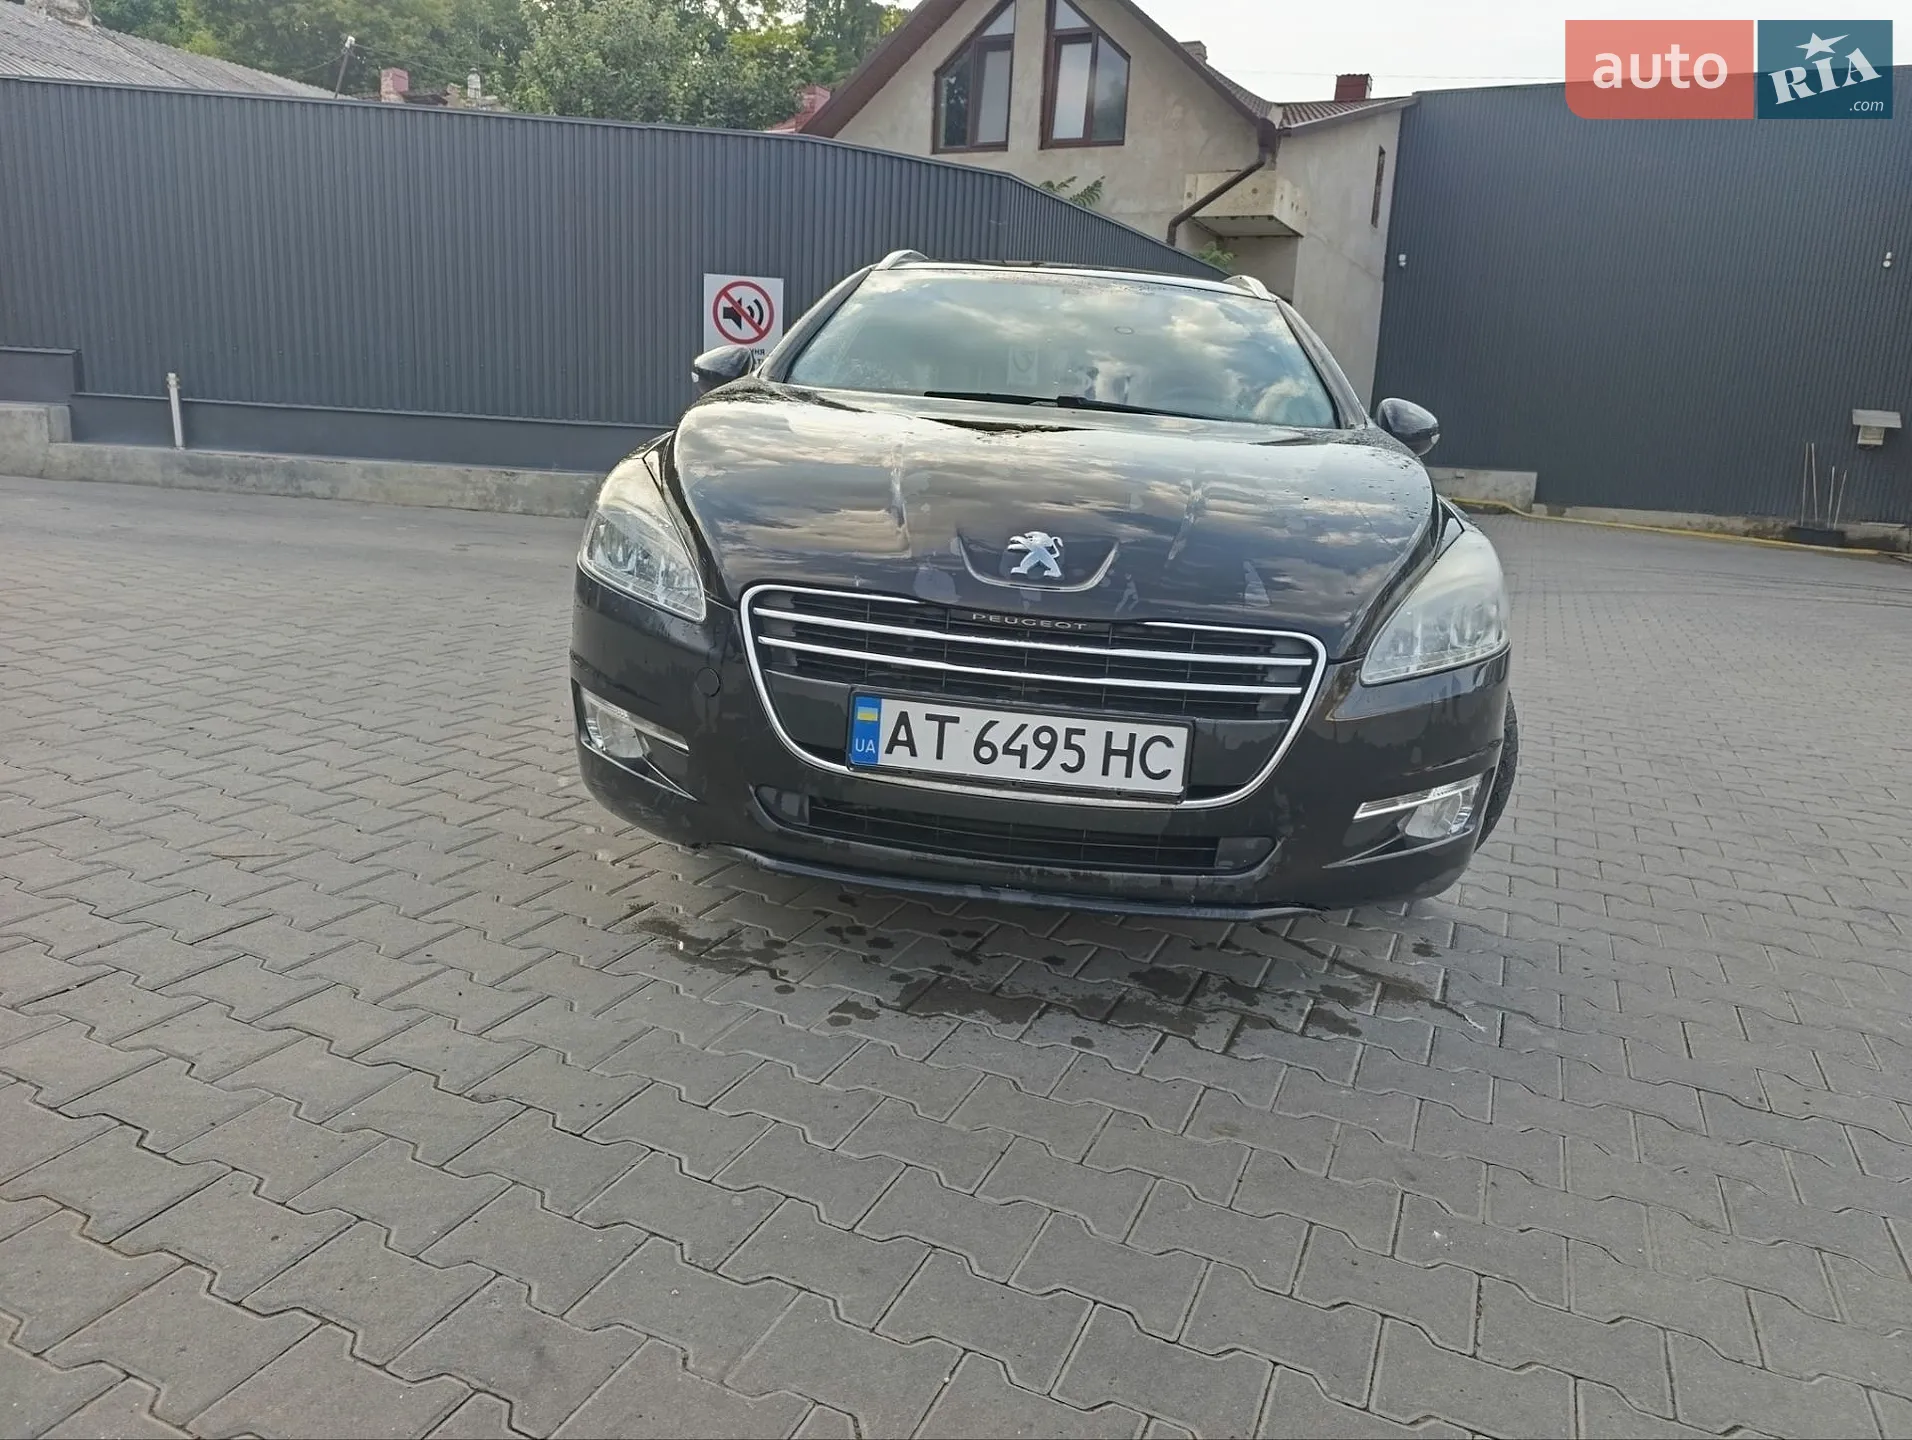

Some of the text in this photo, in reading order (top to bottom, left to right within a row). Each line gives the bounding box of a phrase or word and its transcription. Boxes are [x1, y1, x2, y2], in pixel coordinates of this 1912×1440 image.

[972, 613, 1087, 630] PEUGEOT
[855, 738, 876, 754] UA
[884, 710, 1175, 780] AT 6495 HC
